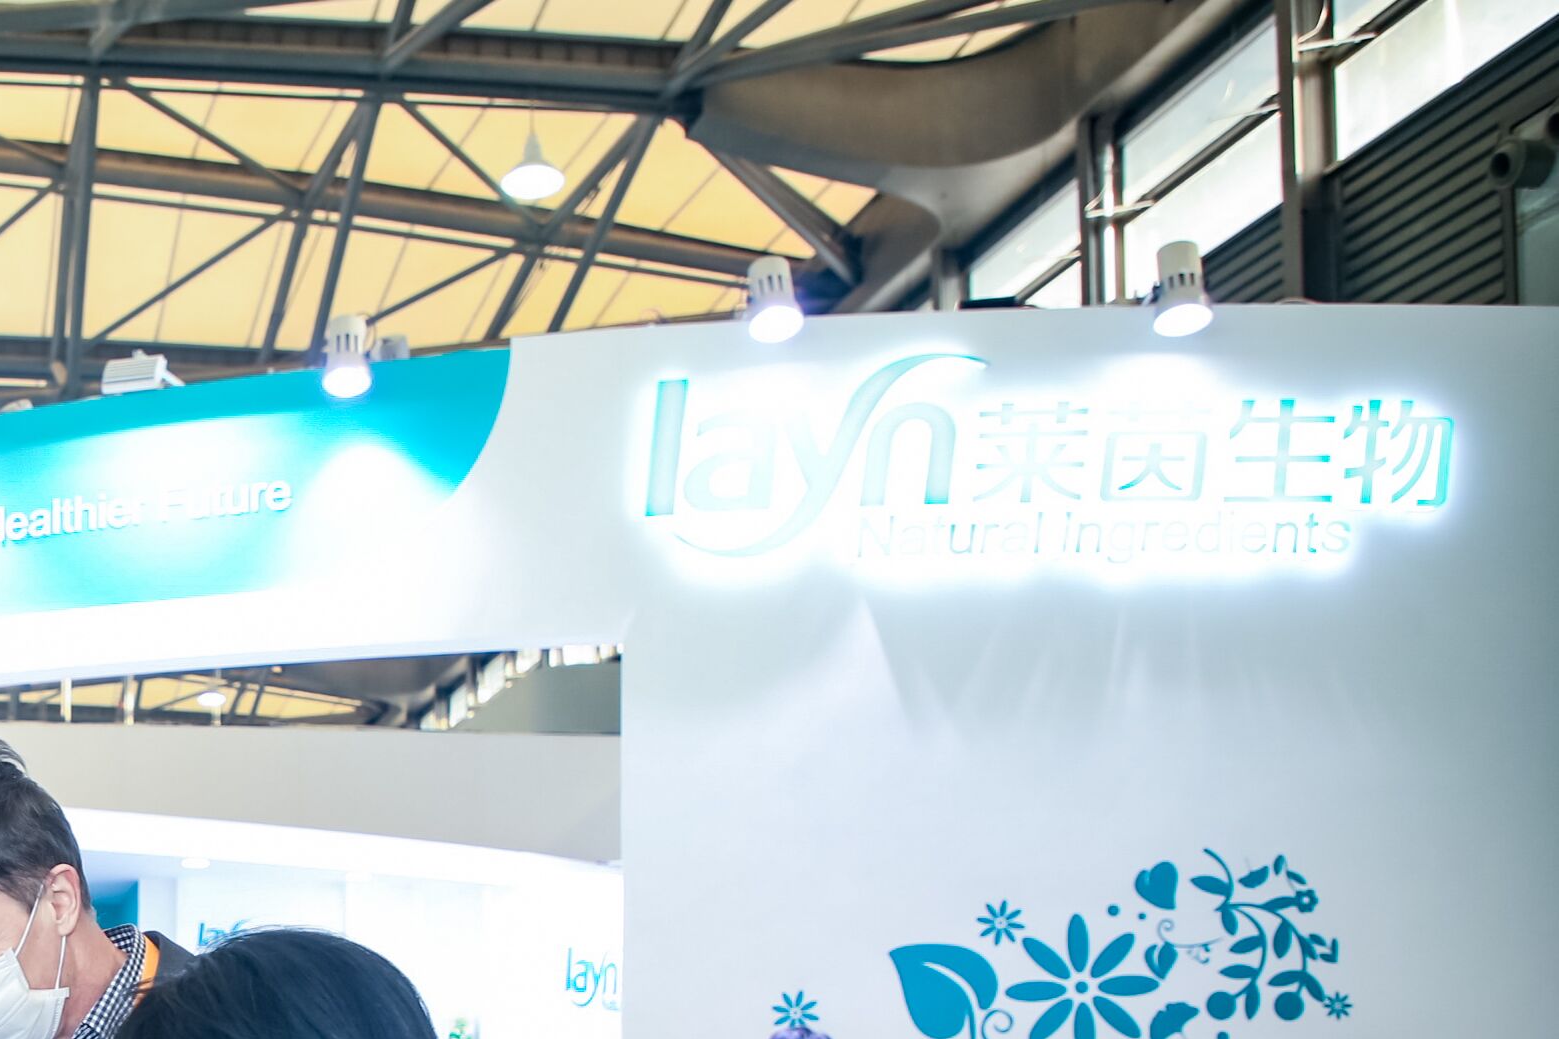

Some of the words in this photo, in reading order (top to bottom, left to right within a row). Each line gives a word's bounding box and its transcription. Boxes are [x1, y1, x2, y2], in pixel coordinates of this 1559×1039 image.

[644, 353, 989, 558] layn
[974, 398, 1454, 509] 莱茵生物
[161, 479, 293, 523] Future
[857, 511, 1042, 558] Natural
[1062, 511, 1351, 564] Ingredients
[565, 947, 619, 1008] layn
